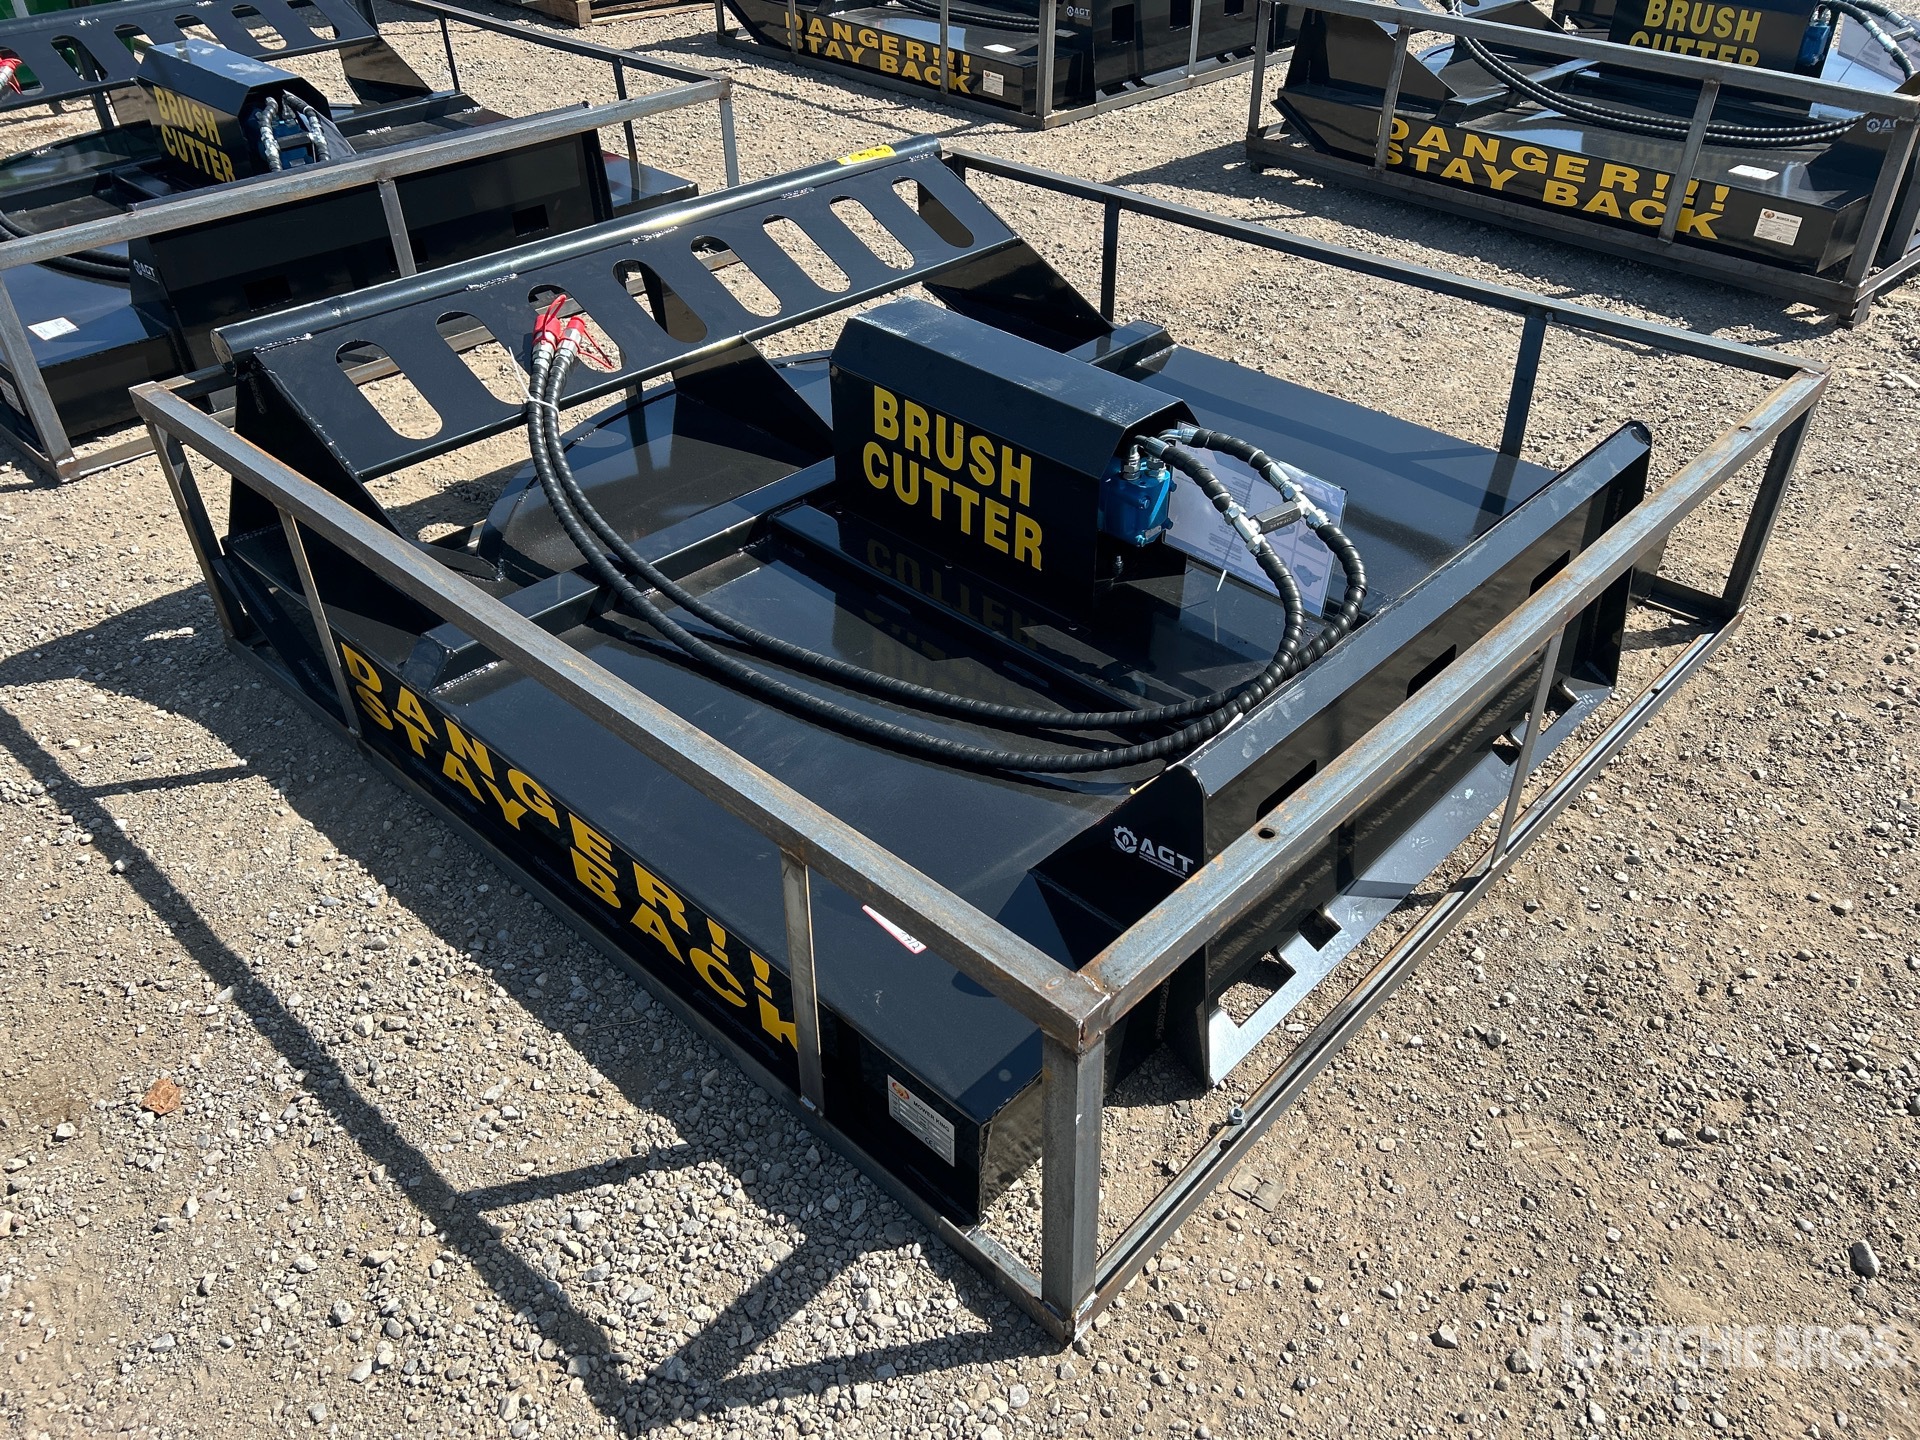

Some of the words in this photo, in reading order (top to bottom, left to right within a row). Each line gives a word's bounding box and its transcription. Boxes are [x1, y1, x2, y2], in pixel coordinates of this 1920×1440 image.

[1643, 0, 1762, 43] BRUSH
[786, 31, 865, 64] STAY
[879, 53, 971, 94] BACK
[153, 85, 222, 147] BRUSH
[161, 123, 236, 183] CUTTER
[1373, 141, 1518, 191] STAY
[1542, 179, 1724, 240] BACK
[874, 385, 1032, 507] BRUSH
[863, 441, 1043, 571] CUTTER
[355, 684, 528, 831] STAY
[569, 846, 799, 1053] BACK
[1140, 837, 1194, 873] AGT
[913, 1100, 935, 1121] MOWER
[935, 1117, 950, 1133] KING
